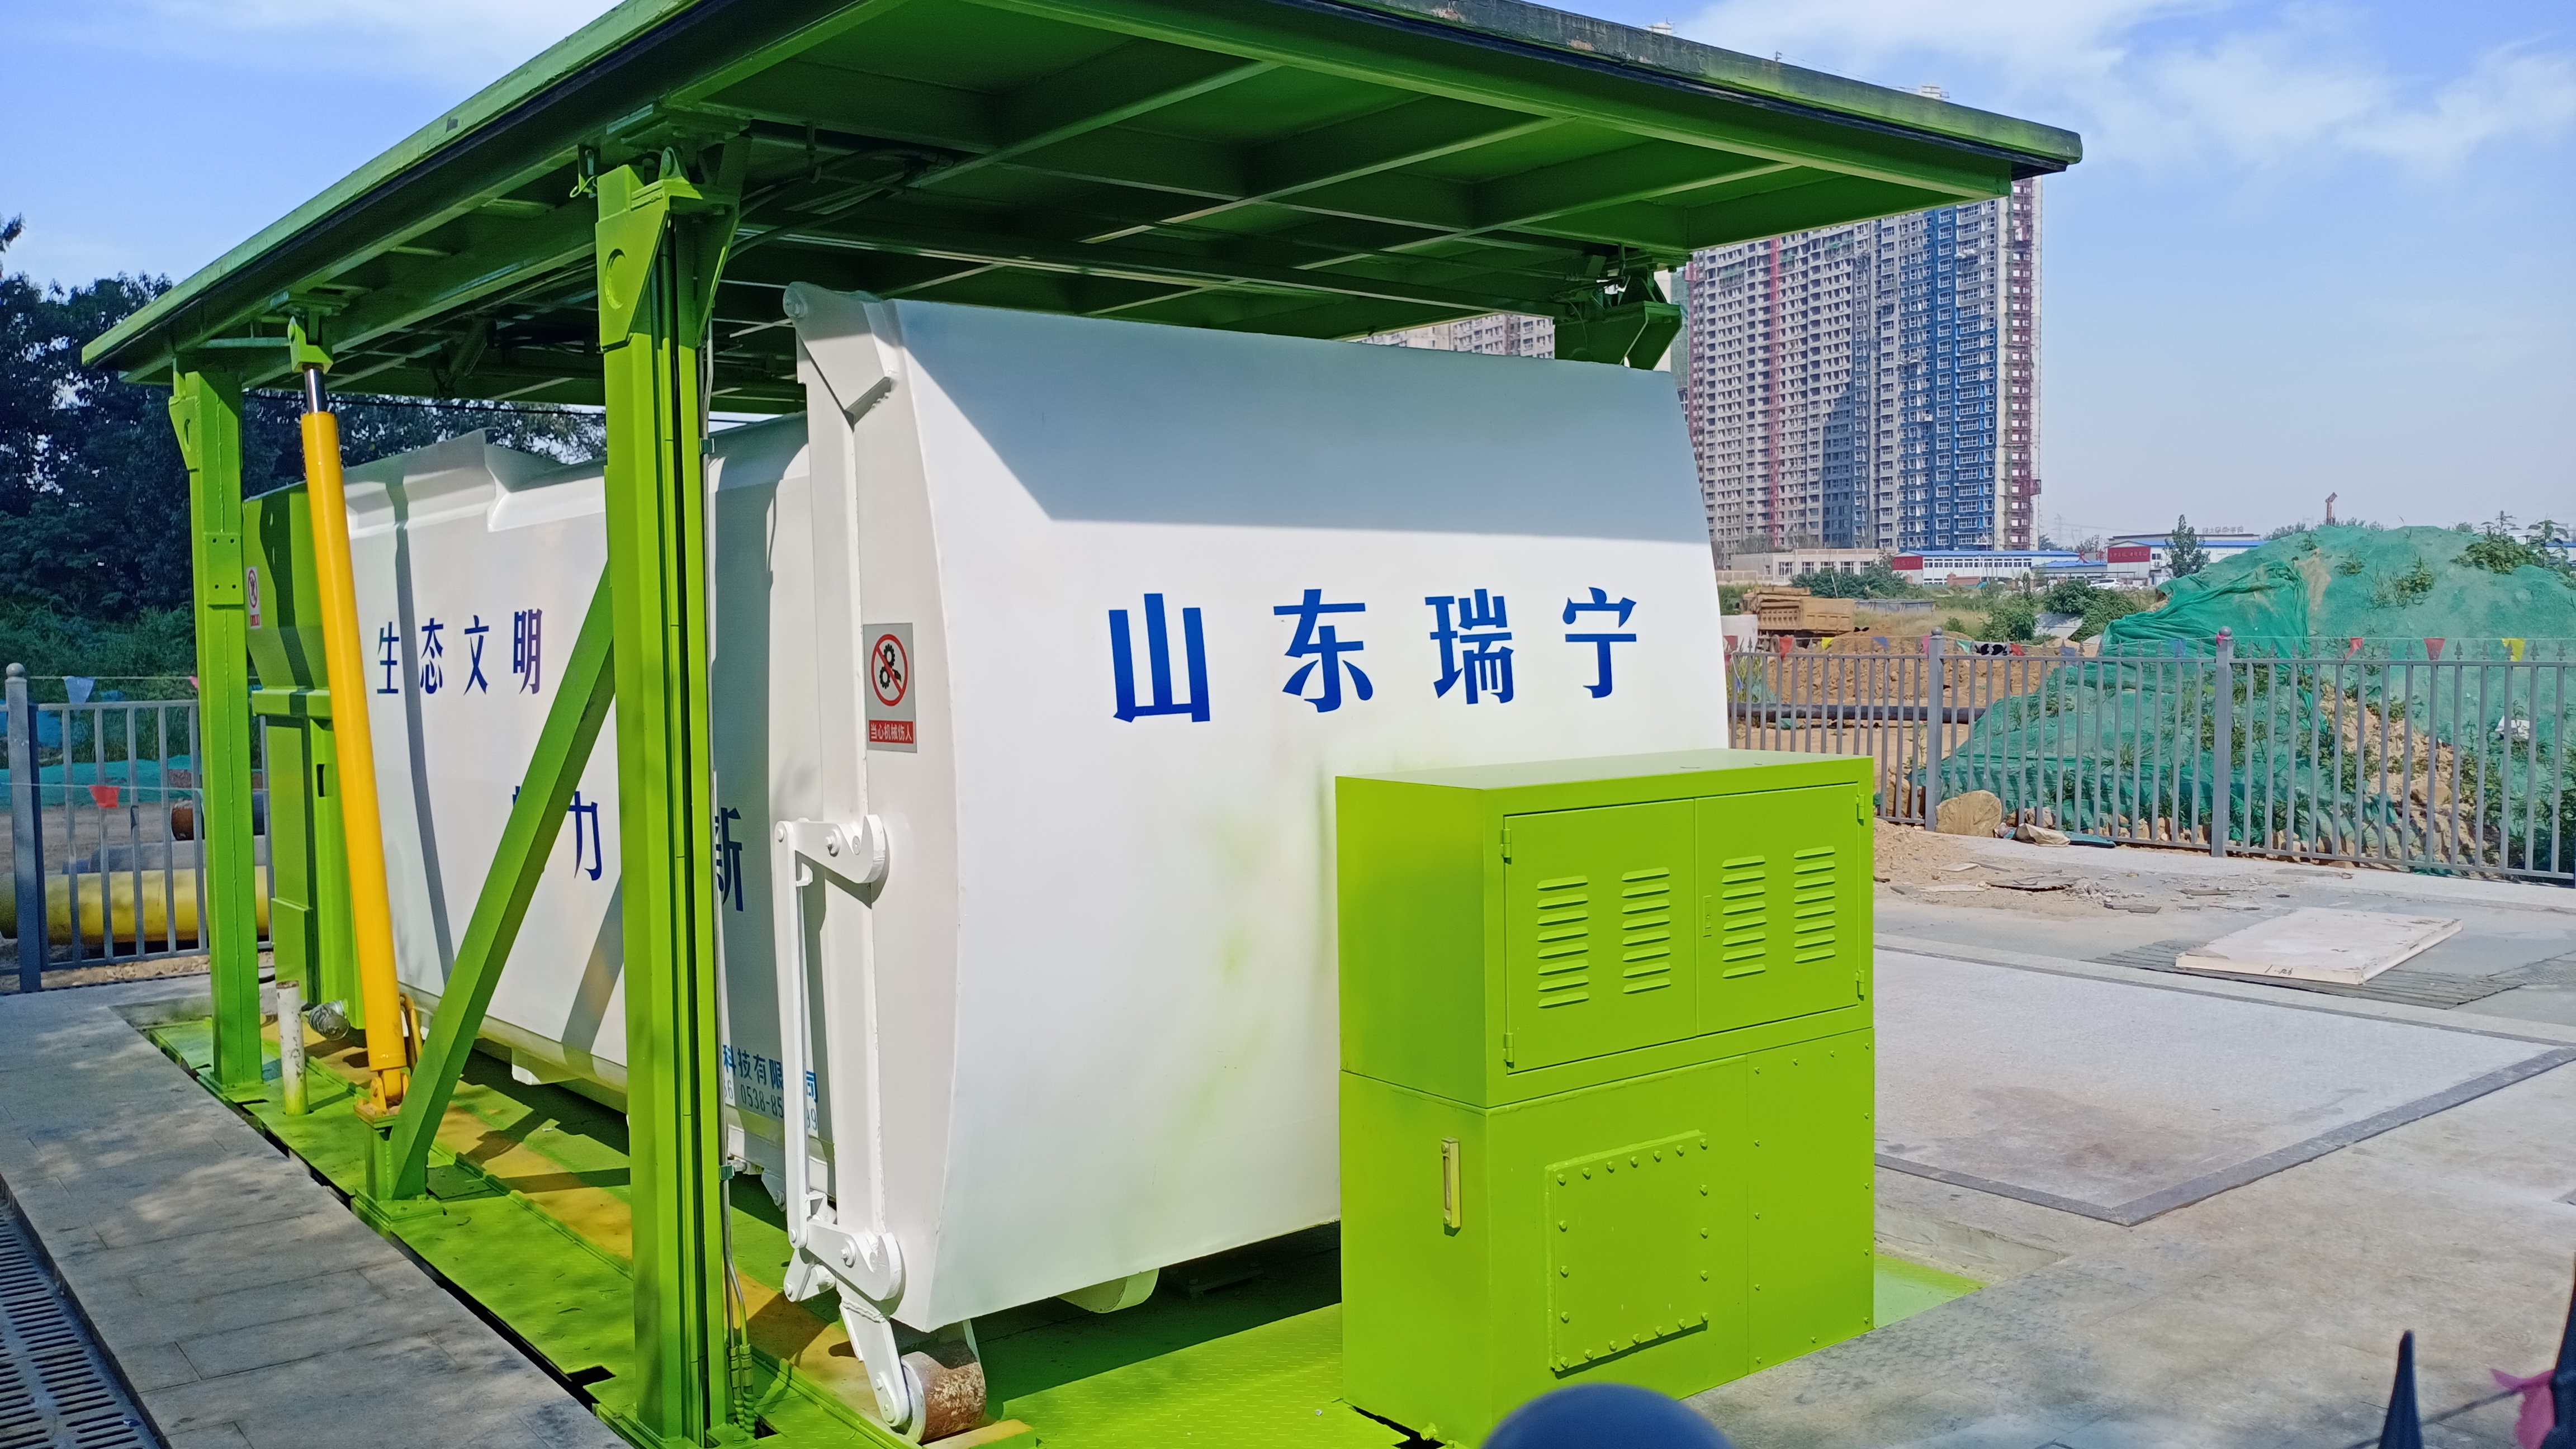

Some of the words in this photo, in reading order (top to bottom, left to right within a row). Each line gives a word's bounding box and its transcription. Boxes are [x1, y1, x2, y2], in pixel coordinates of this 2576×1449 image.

[376, 608, 543, 695] 生态文明
[1109, 586, 1637, 722] 山东瑞宁
[870, 723, 912, 741] 当心机械伤人
